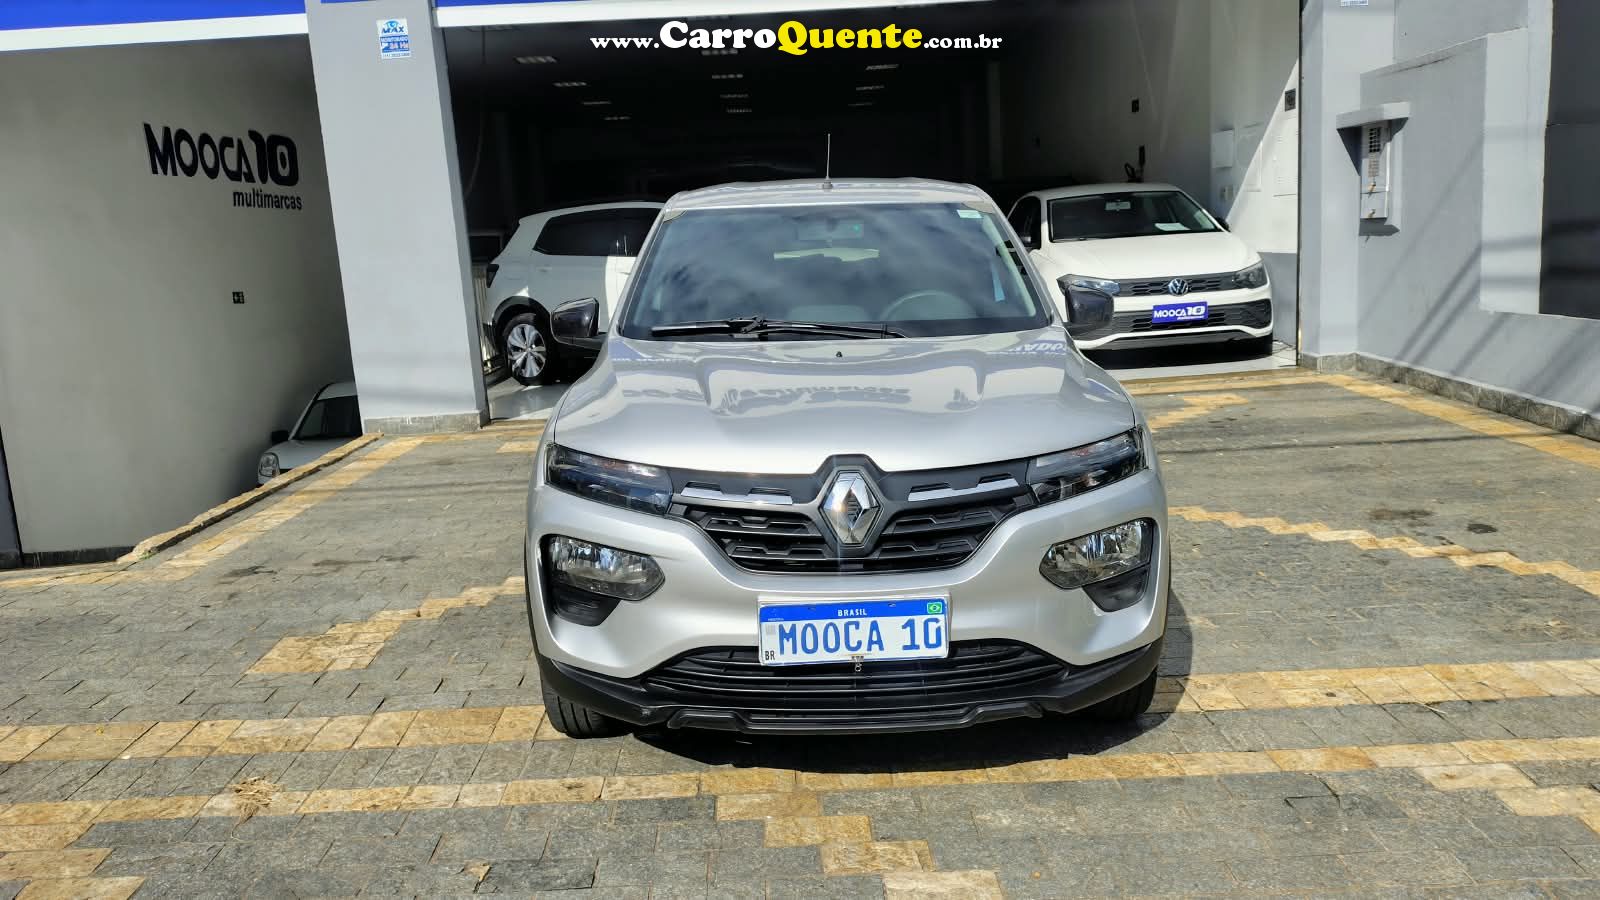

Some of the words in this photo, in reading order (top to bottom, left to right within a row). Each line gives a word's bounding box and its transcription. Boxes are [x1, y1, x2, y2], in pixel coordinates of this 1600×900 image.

[233, 188, 302, 210] multimarcas
[837, 608, 868, 618] BRASIL
[778, 619, 885, 656] MOOCA
[901, 617, 943, 651] 10
[764, 650, 776, 661] BR
